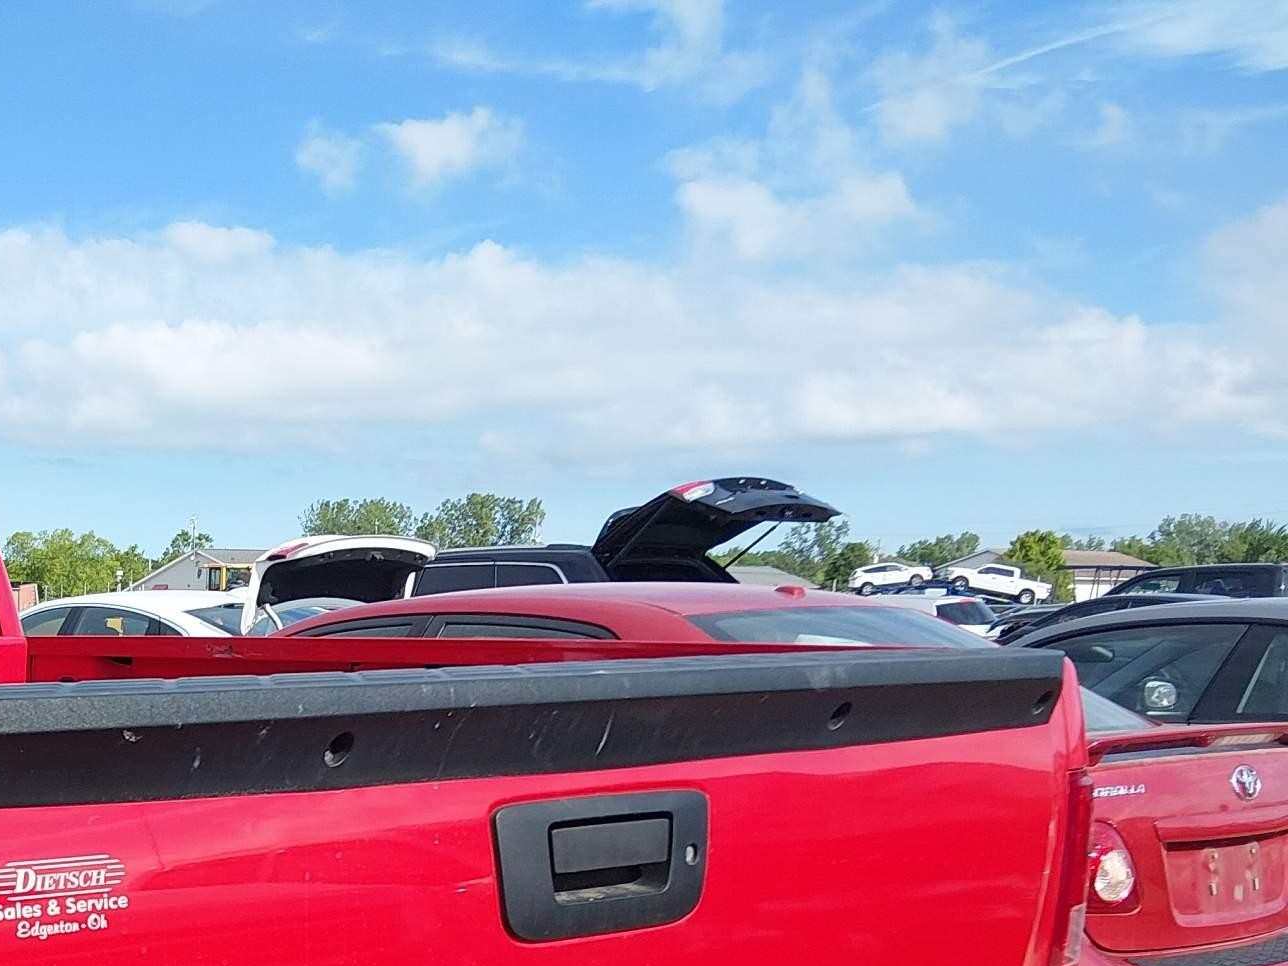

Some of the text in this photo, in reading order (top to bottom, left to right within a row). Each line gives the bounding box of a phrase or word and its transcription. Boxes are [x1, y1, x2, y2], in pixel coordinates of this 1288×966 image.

[1092, 784, 1145, 798] OROLLA
[47, 899, 61, 916] &
[65, 893, 129, 914] Service
